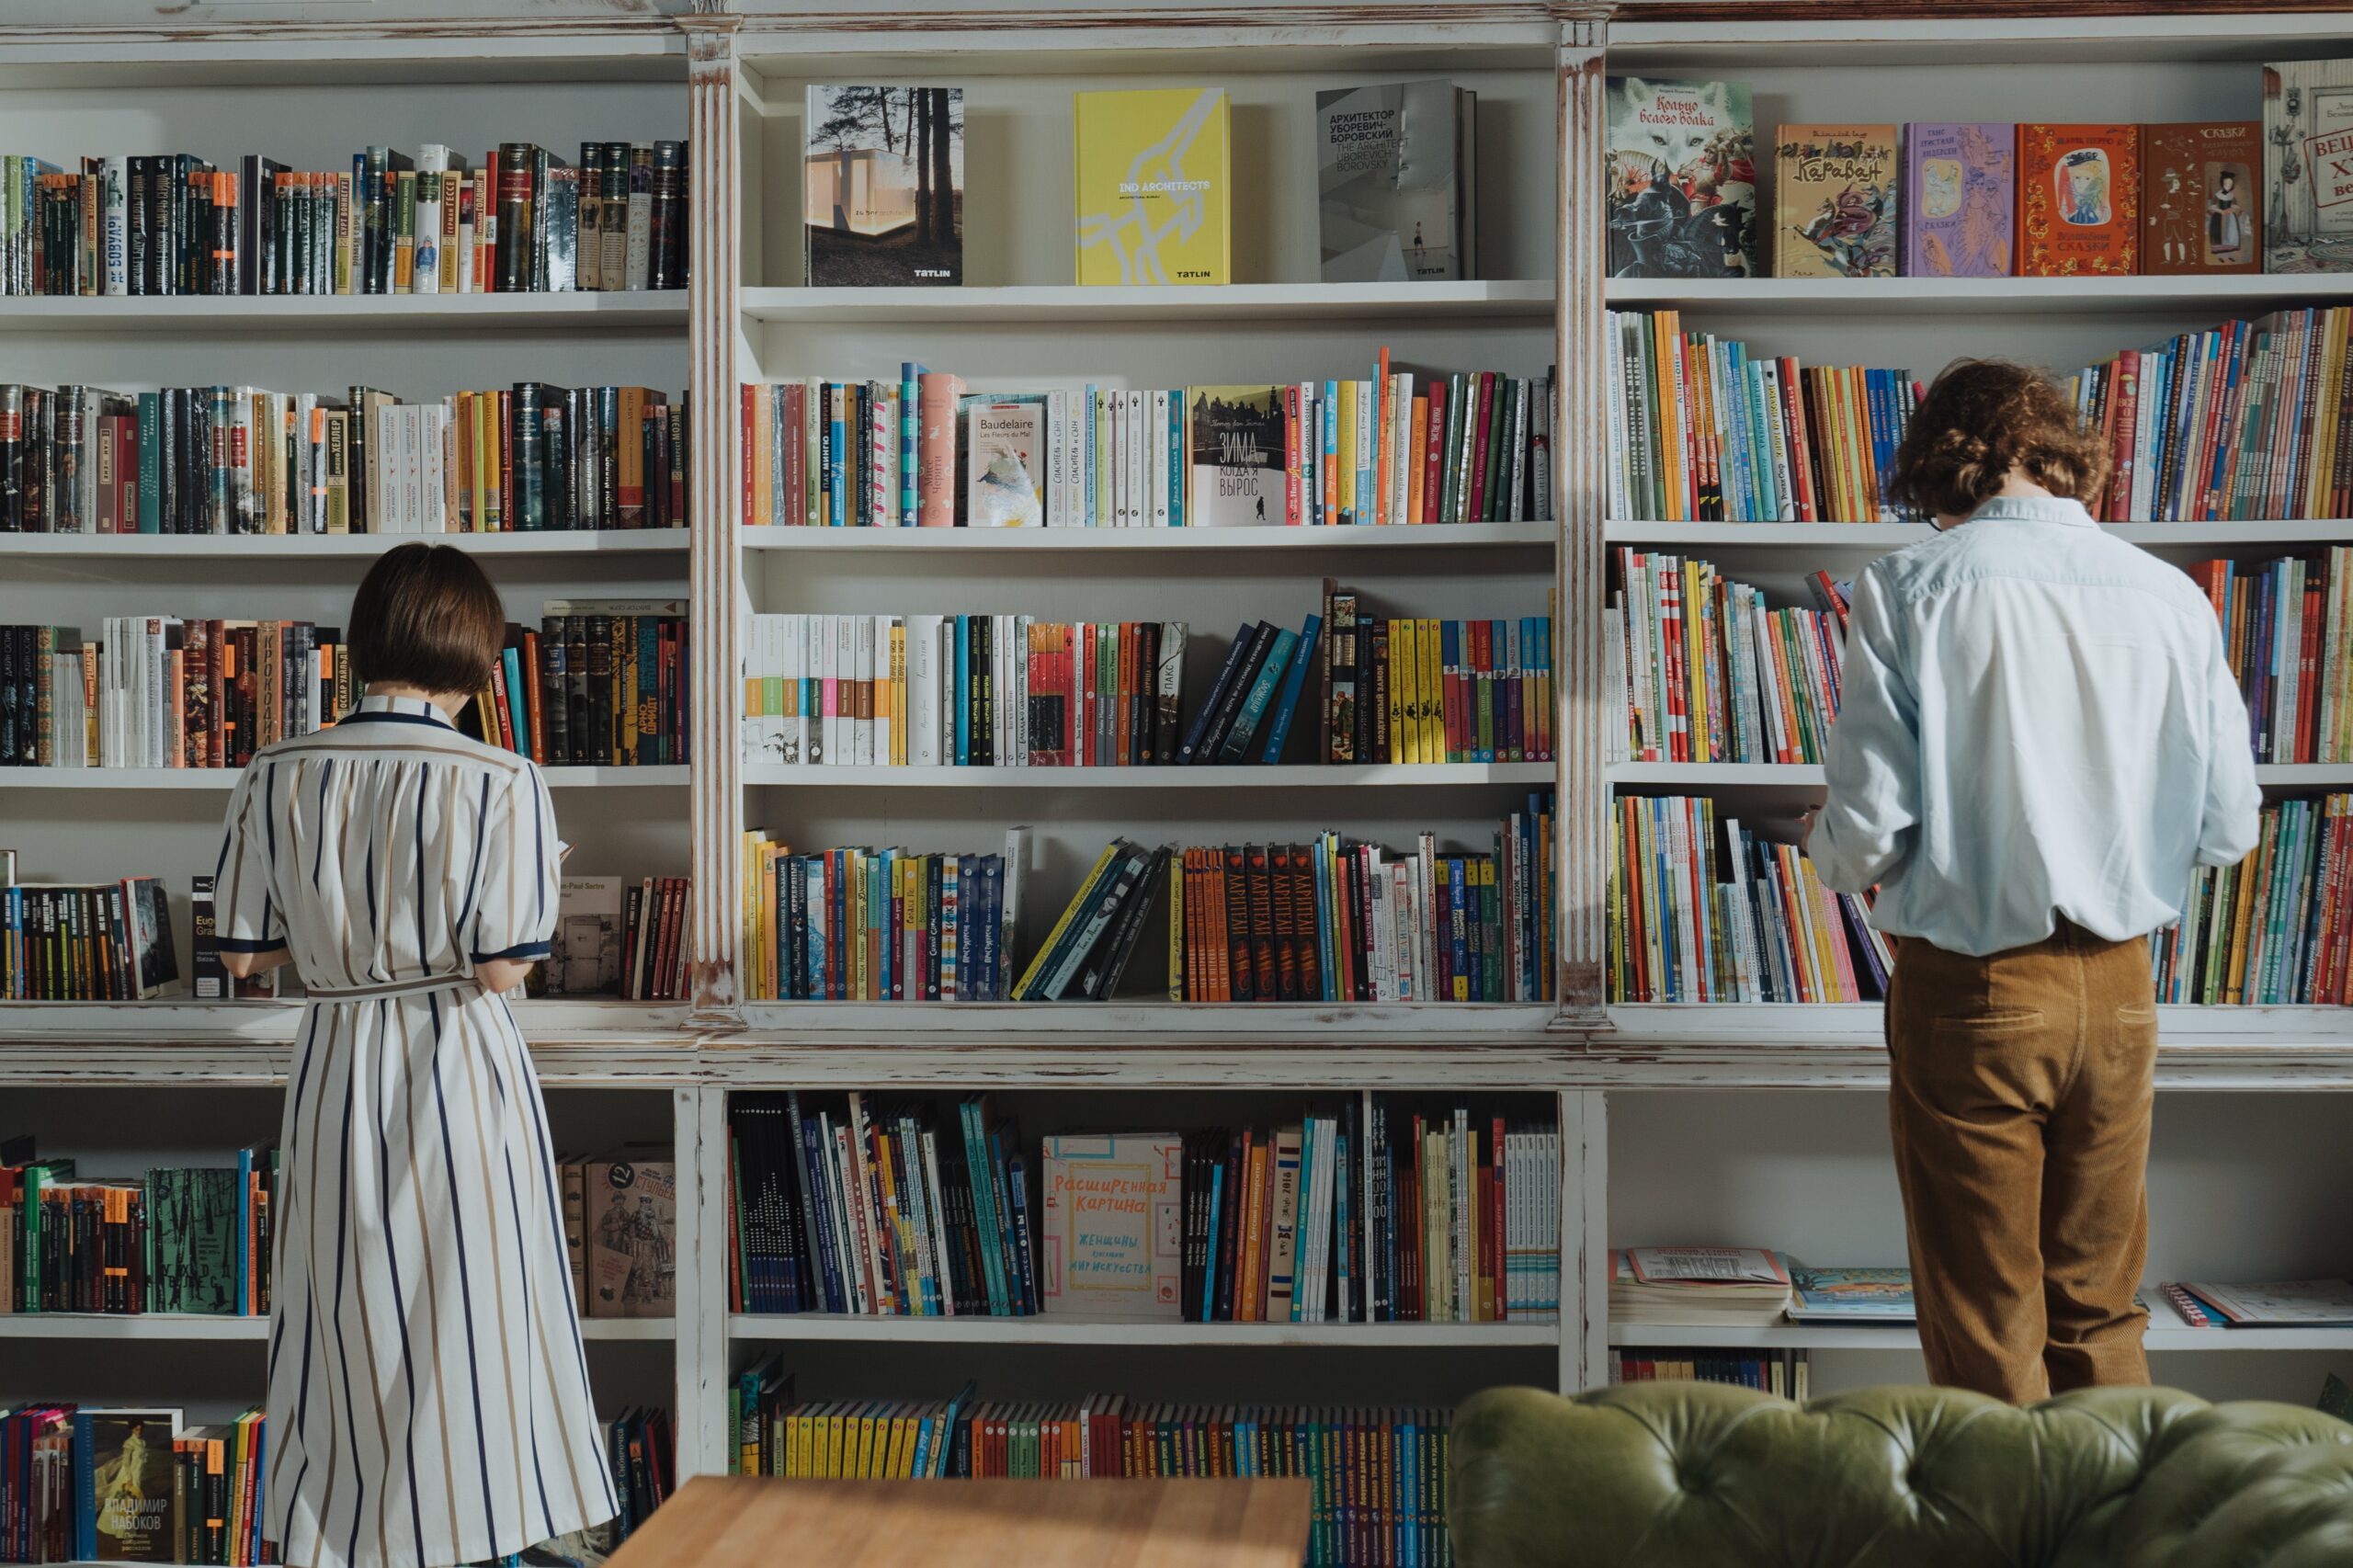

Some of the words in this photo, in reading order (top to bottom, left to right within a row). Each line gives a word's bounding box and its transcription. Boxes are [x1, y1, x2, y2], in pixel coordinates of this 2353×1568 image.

[1329, 109, 1395, 125] АРХИТЕКТОР
[1329, 121, 1387, 134] УБОРЕВИЧ-
[1330, 130, 1393, 143] БОРОВСКИЙ
[1336, 142, 1354, 153] THE
[1357, 137, 1410, 151] ARCHITECT
[1336, 150, 1395, 163] UBOREVICH-
[1336, 159, 1389, 172] BOROVSKY
[155, 174, 170, 199] СЕРДЦА
[340, 180, 348, 217] ВОННЕГУТ
[441, 180, 455, 207] ГЕССЕ
[474, 177, 484, 212] ГОЛДИНГ
[1120, 183, 1139, 193] IND
[1142, 181, 1211, 192] ARCHITECTS
[156, 200, 169, 228] СМЕРТЬ
[340, 218, 348, 235] КУРТ
[447, 208, 455, 233] ГЕРМАН
[108, 220, 122, 267] БОВУАР
[157, 232, 169, 257] БОУЭН
[2057, 241, 2110, 251] СКАЗКИ
[110, 270, 123, 283] ДЕ
[157, 257, 169, 289] ЭЛИЗАБЕТ
[1625, 356, 1633, 385] МЕЛОМ
[1632, 356, 1641, 385] МЕЛОМ
[1689, 347, 1699, 379] ИРИСОК
[1699, 347, 1709, 379] ИРИСОК
[1627, 388, 1634, 400] ЗА
[1635, 388, 1642, 400] ЗА
[1692, 380, 1699, 390] ОТ
[1702, 380, 1710, 390] ОТ
[1753, 378, 1763, 409] ЦВЕТОК
[1692, 390, 1701, 422] БУМАЖЕК
[1703, 390, 1712, 422] БУМАЖЕК
[671, 415, 681, 440] МОЭМ
[980, 419, 1034, 430] Baudelaire
[1628, 406, 1637, 442] Махотин
[1636, 406, 1644, 442] Махотин
[1755, 412, 1766, 449] ХРАБРЫЙ
[1220, 432, 1260, 464] ЗИМА,
[1630, 446, 1639, 476] Сергей
[1638, 446, 1646, 476] Сергей
[605, 456, 615, 488] Миллер
[924, 459, 934, 487] Мисс
[933, 455, 943, 494] Черити
[1220, 465, 1250, 477] КОГДА
[1252, 465, 1258, 476] Я
[1220, 477, 1258, 496] ВЫРОС
[605, 489, 614, 515] Генри
[647, 628, 656, 656] ДЕТИ
[24, 654, 32, 677] ДЖЕЙН
[337, 653, 347, 684] УАЙЛЬД
[639, 628, 648, 690] НИЧЕЙНОГО
[647, 659, 656, 690] ОТЦА
[1164, 665, 1175, 689] ПАКС
[339, 685, 348, 709] ОСКАР
[241, 696, 251, 753] Фицджеральд
[639, 704, 648, 734] АРНО
[647, 695, 657, 735] ШМИДТ
[1377, 693, 1386, 745] ВОЗДУШНЫЙ
[22, 900, 30, 919] THEATRE
[96, 893, 106, 911] TRIOMPHE
[110, 892, 122, 920] NOVELLEN
[780, 899, 786, 907] ЗА
[98, 919, 107, 931] ARC
[945, 900, 955, 933] КИМКА
[1398, 909, 1406, 932] СЛОН
[1400, 940, 1408, 968] ЭРИКА
[610, 1165, 631, 1186] 12
[1252, 1161, 1262, 1209] университет
[1283, 1172, 1292, 1194] 2018
[803, 1192, 813, 1219] ТРОЯ
[1249, 1210, 1260, 1242] Детский
[1395, 1473, 1401, 1482] НА
[1431, 1468, 1438, 1479] НА
[1359, 1475, 1368, 1506] Ловушка
[104, 1498, 167, 1515] ВЛАДИМИР
[110, 1515, 161, 1530] НАБОКОВ
